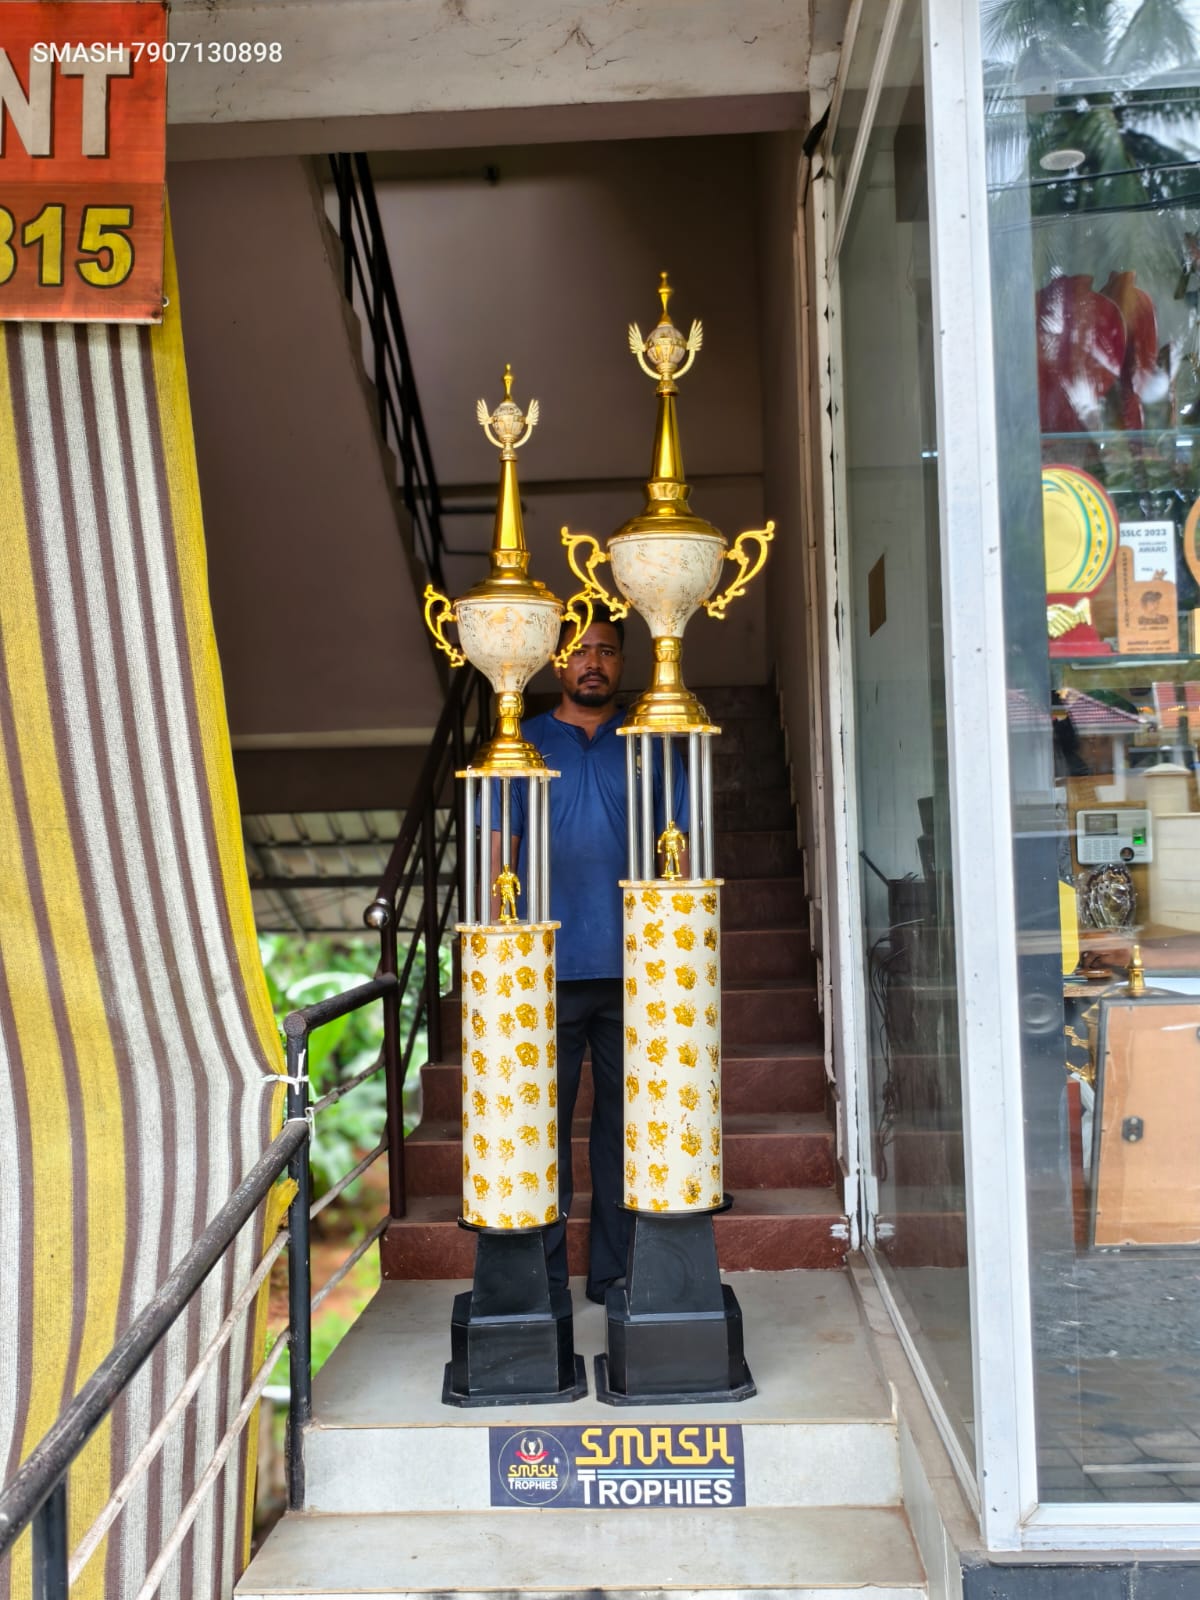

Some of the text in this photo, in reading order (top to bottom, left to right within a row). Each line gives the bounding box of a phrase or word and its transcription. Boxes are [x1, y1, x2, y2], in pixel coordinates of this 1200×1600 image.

[575, 1427, 735, 1465] SMASH
[507, 1464, 559, 1477] SMASH
[507, 1477, 558, 1490] TROPHIES
[577, 1469, 734, 1505] TROPHIES
